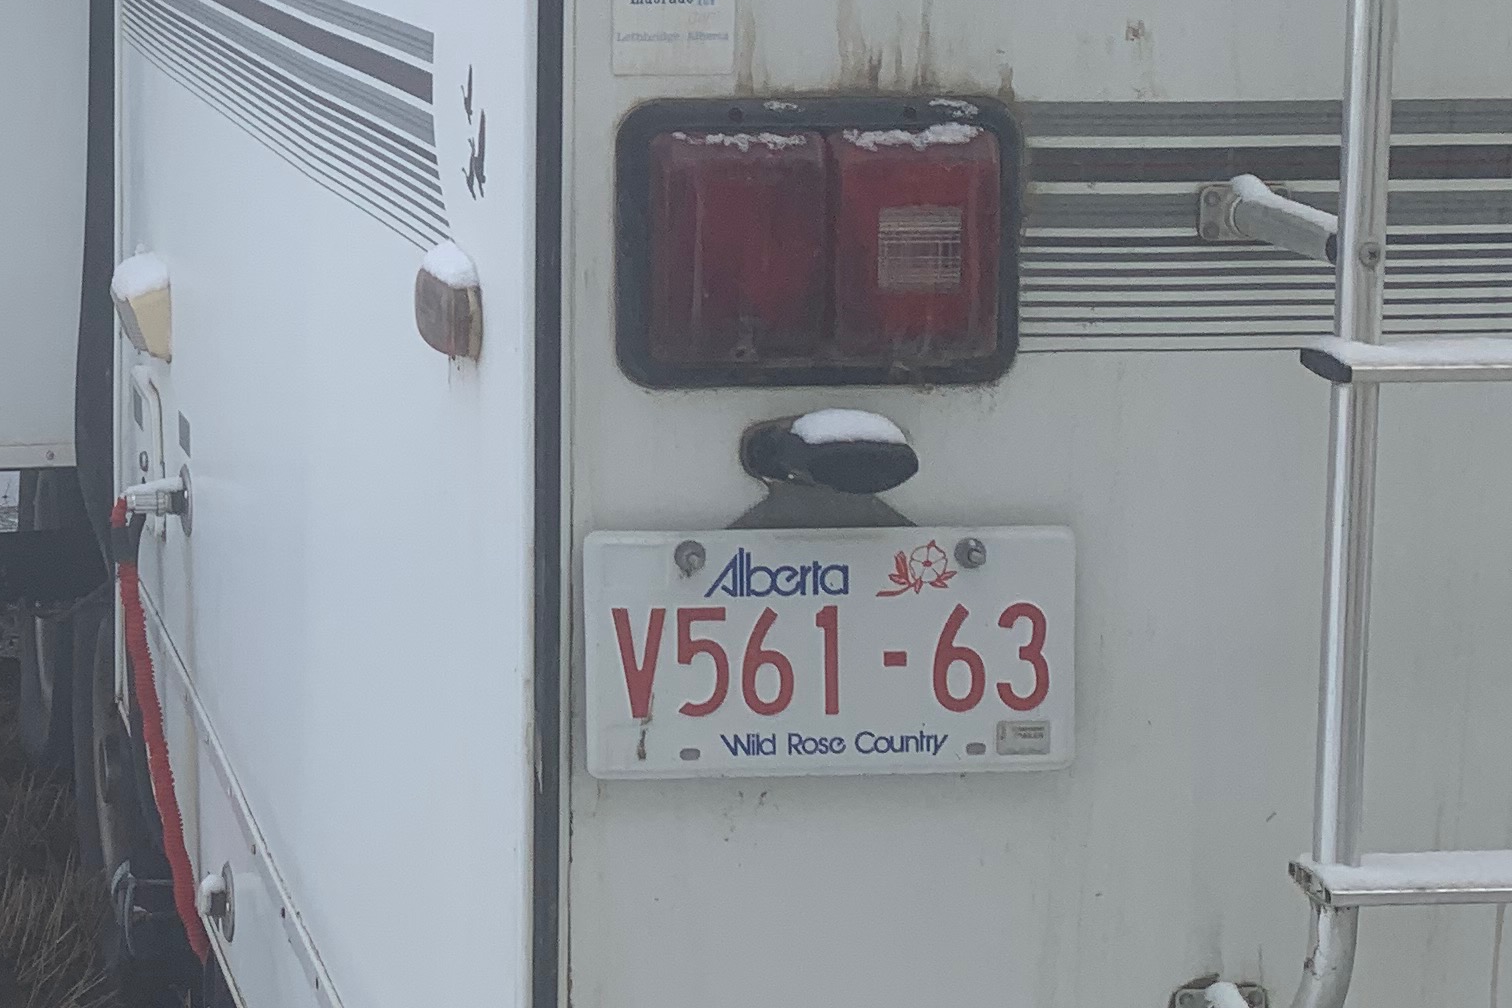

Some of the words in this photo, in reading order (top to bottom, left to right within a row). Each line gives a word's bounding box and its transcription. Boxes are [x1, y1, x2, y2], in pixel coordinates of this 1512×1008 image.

[703, 547, 849, 598] Alberta
[720, 734, 776, 757] Wild
[788, 733, 846, 756] Rose
[855, 731, 949, 756] Country
